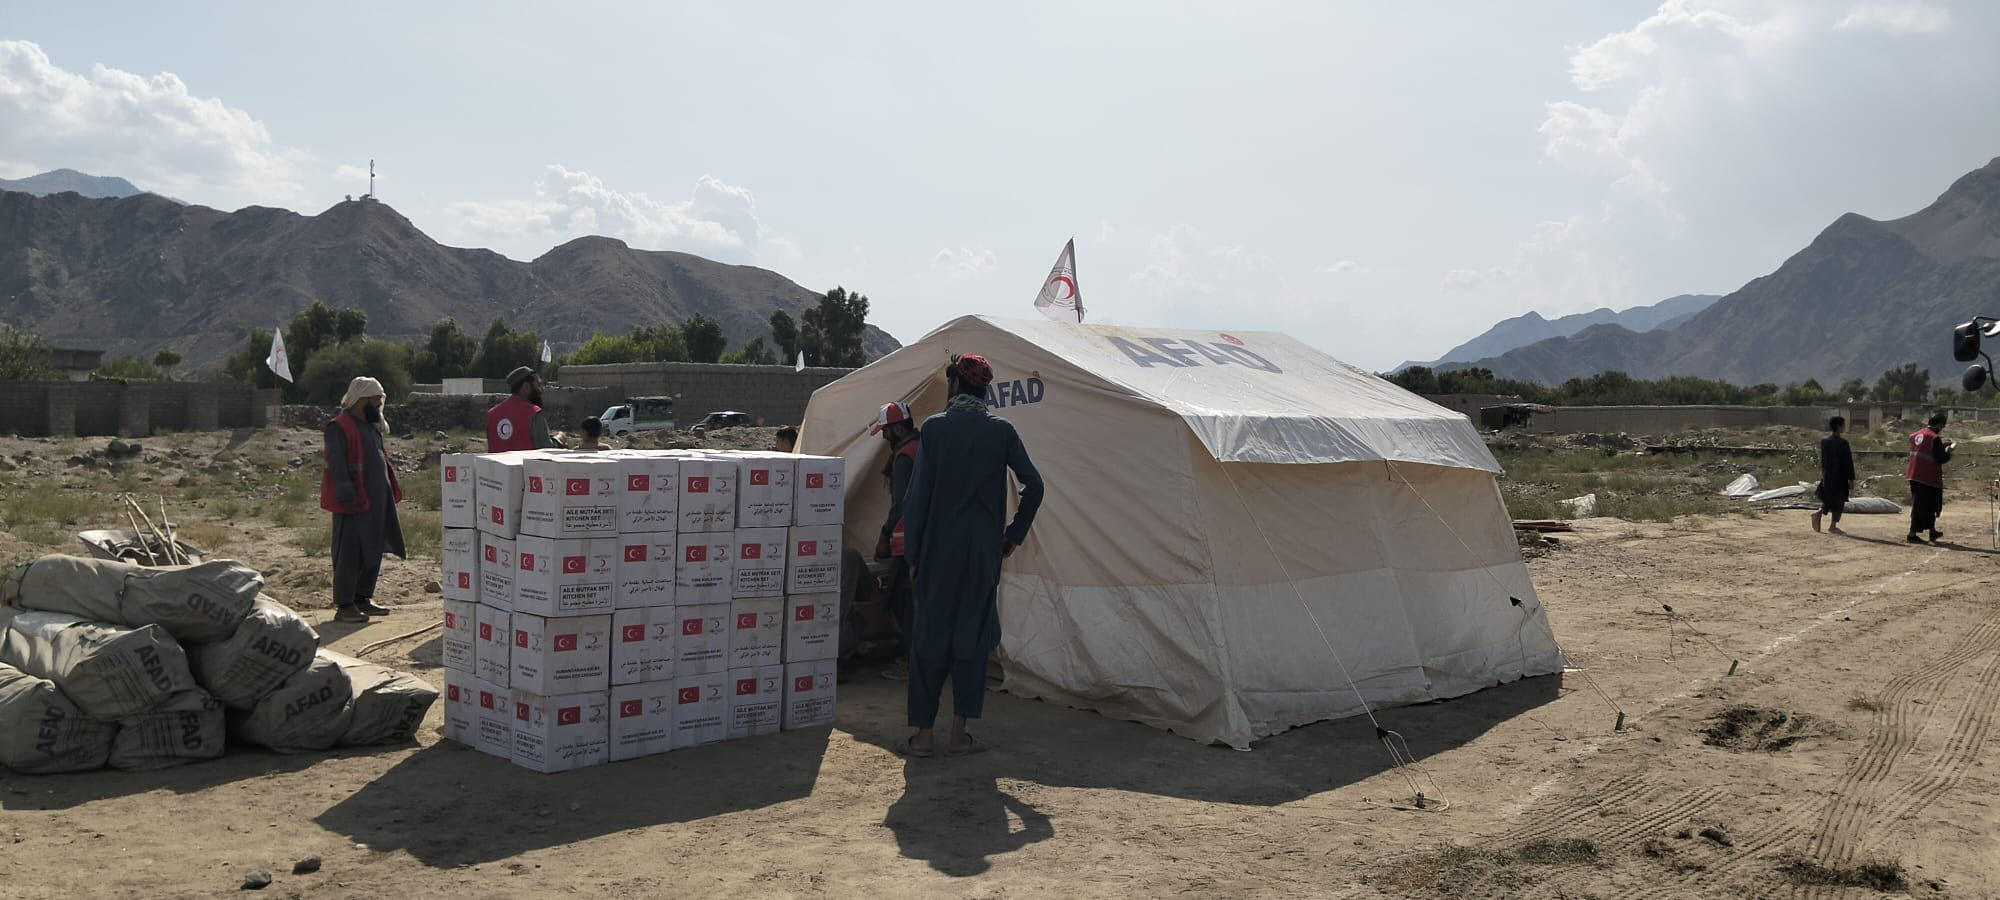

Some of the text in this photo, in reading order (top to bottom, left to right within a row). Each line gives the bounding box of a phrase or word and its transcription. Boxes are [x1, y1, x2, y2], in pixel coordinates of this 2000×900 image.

[1105, 336, 1283, 374] AFAD
[984, 378, 1044, 408] AFAD
[134, 645, 173, 692] AFAD
[252, 636, 302, 666] AFAD
[284, 686, 334, 721] AFAD
[36, 706, 65, 755] AFAD
